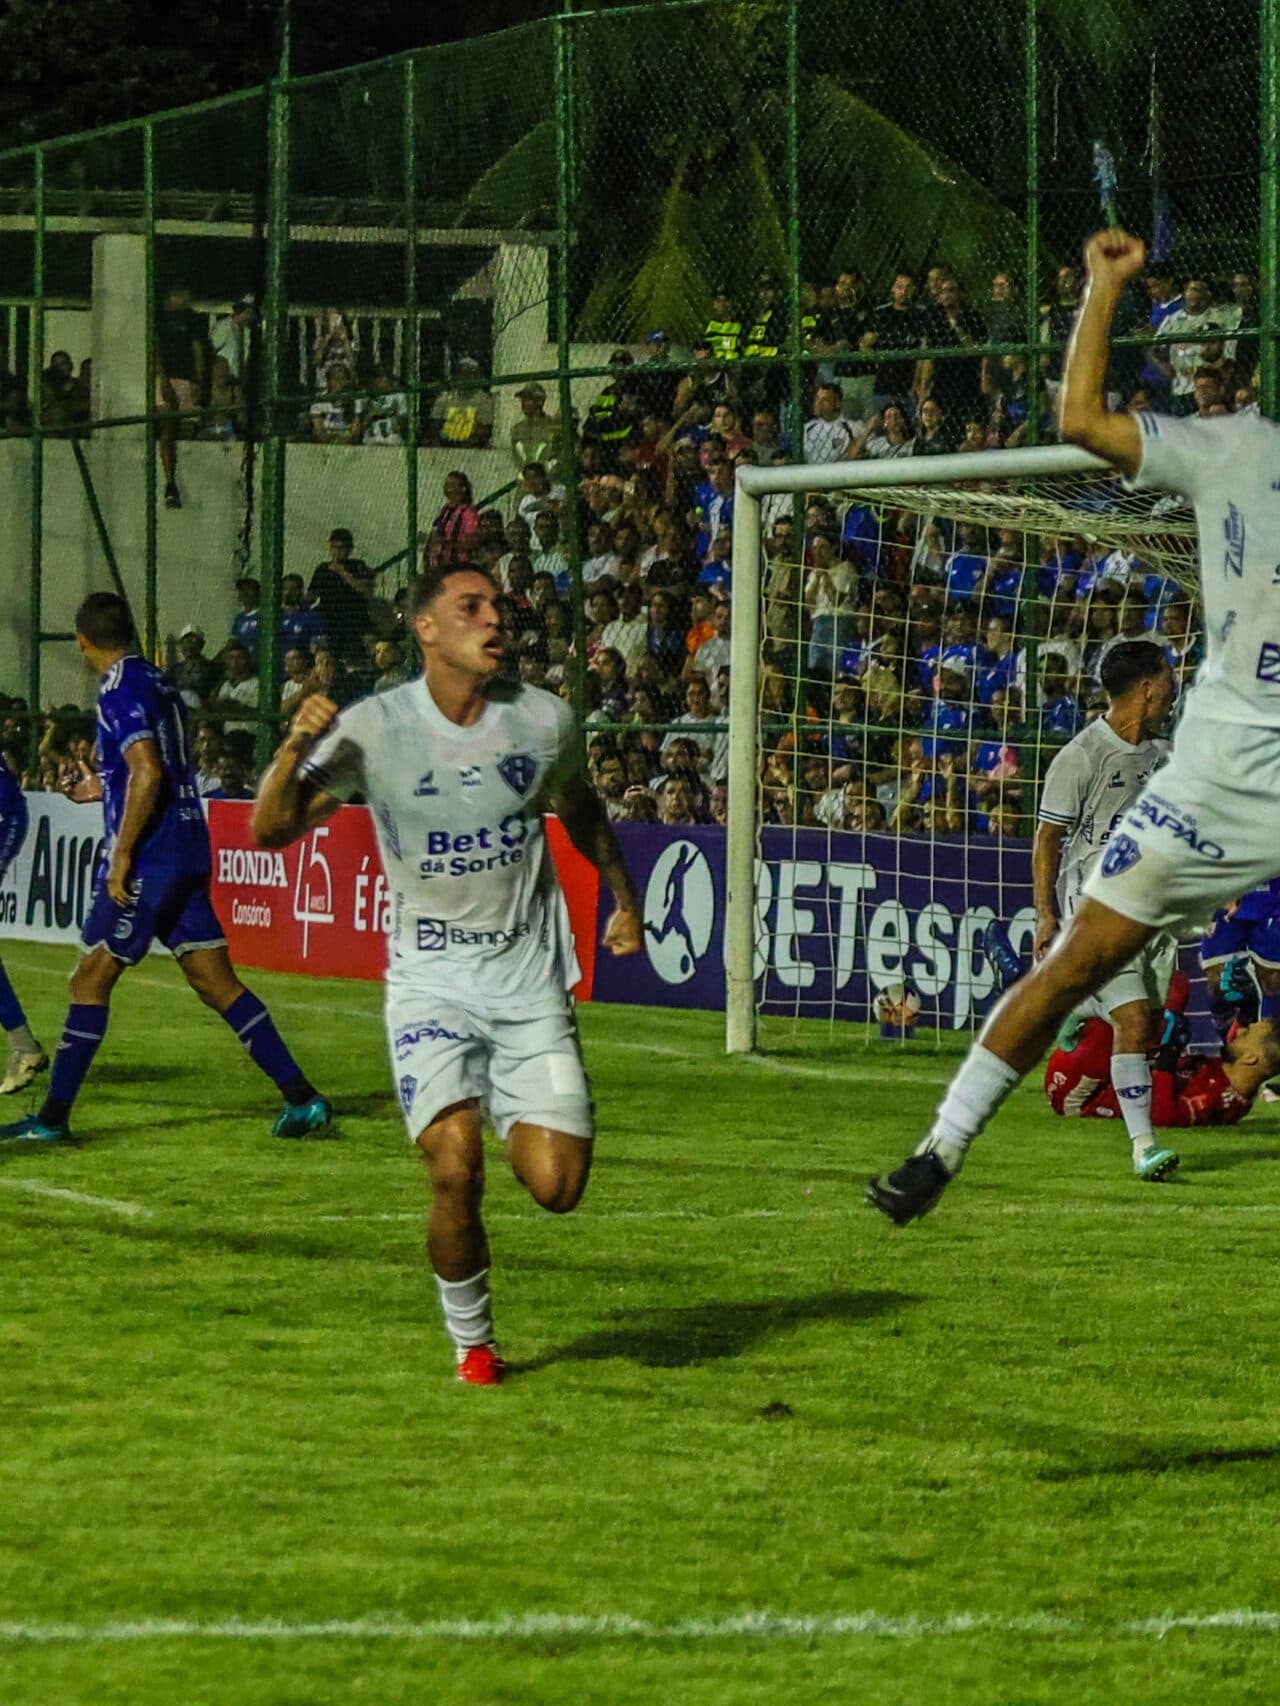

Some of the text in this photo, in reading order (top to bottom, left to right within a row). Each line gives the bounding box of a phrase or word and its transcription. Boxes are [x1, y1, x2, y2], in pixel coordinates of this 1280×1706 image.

[427, 827, 492, 856] Bet
[218, 848, 288, 887] HONDA
[450, 849, 523, 877] Sorte
[354, 855, 369, 931] É
[232, 897, 271, 928] Consórcio
